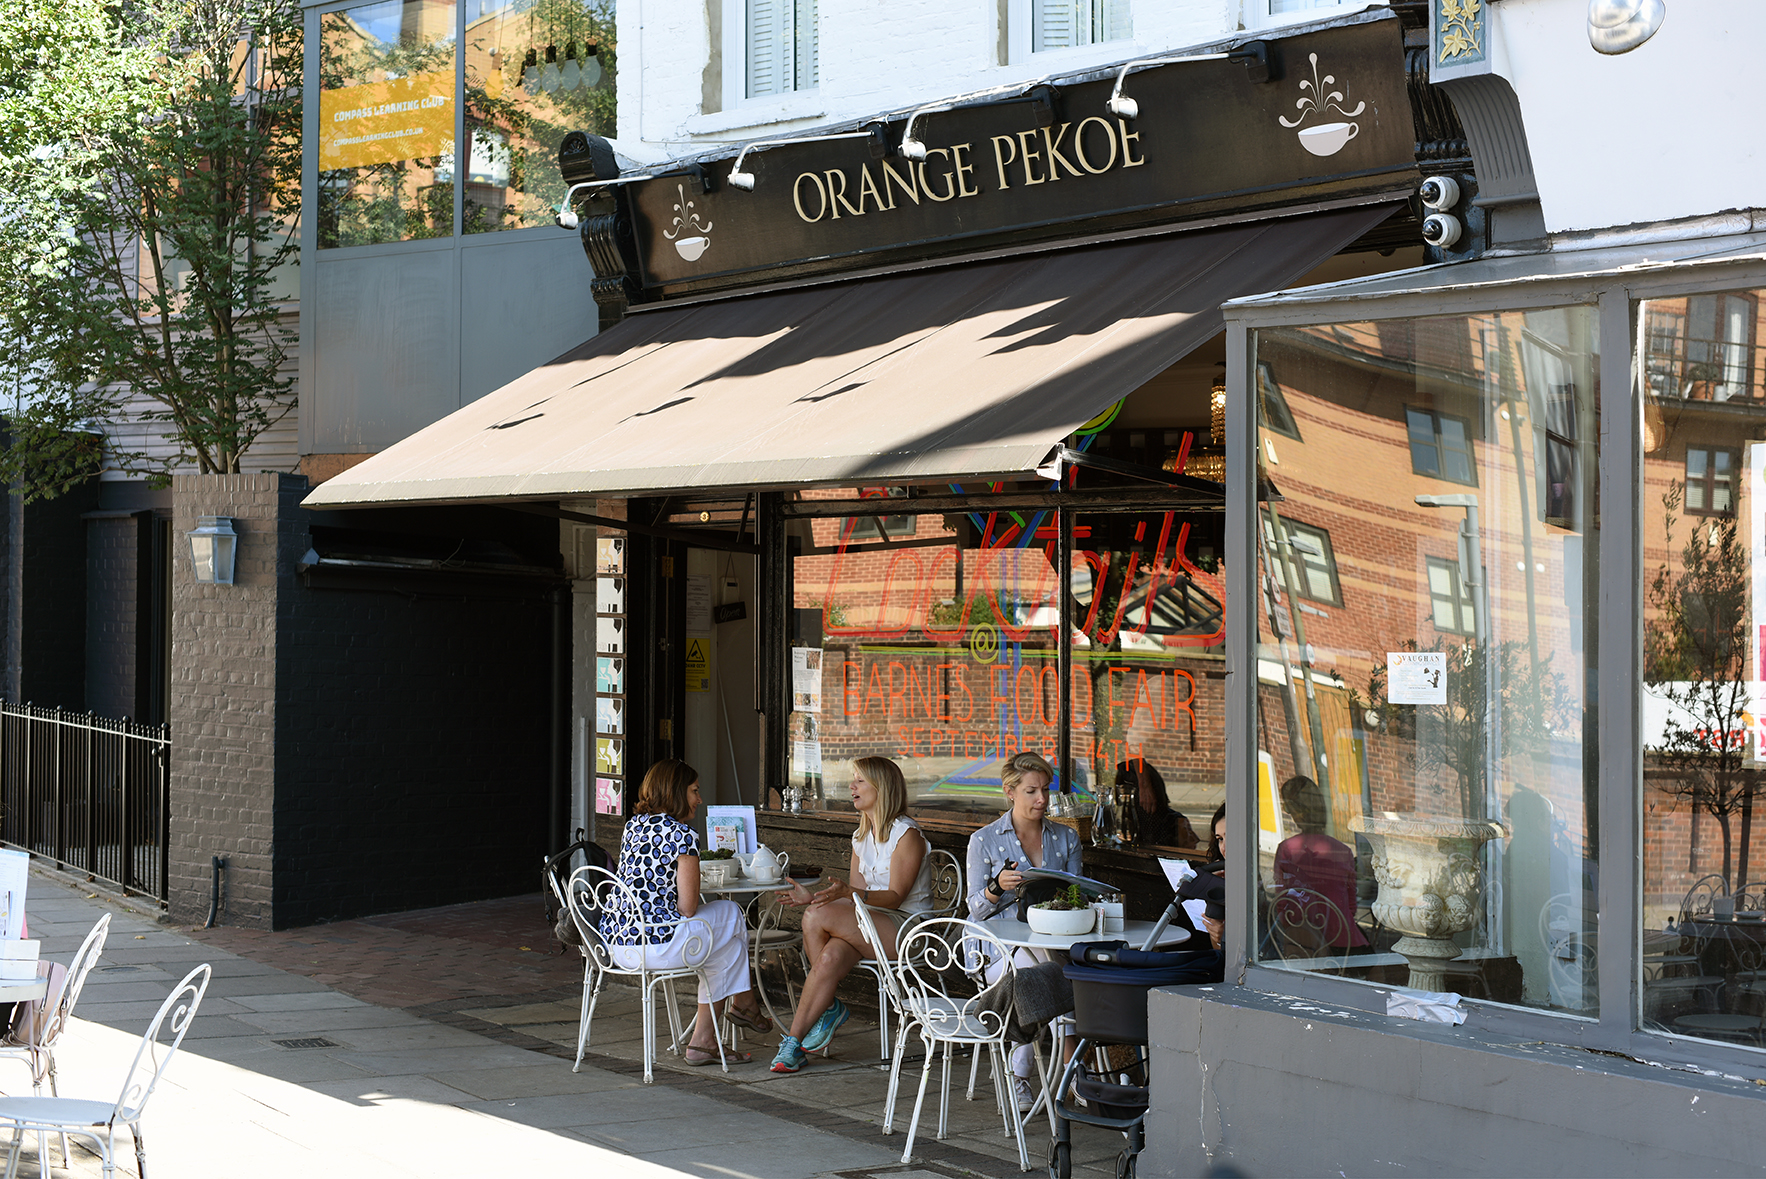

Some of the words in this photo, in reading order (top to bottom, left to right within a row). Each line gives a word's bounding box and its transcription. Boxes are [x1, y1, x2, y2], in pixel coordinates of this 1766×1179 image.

[334, 107, 372, 122] COMPASS
[374, 99, 420, 116] LEARNING
[421, 95, 445, 109] CLUB
[333, 126, 424, 147] COMPASSLEARNINGCLUB.CO.UK
[792, 142, 978, 223] ORANGE
[990, 116, 1145, 190] PEKOE
[720, 606, 741, 622] Open
[970, 622, 999, 665] @
[843, 660, 974, 723] BARNES
[989, 664, 1093, 730] FOOD
[1108, 666, 1196, 732] FAIR
[1085, 738, 1144, 775] 14TH
